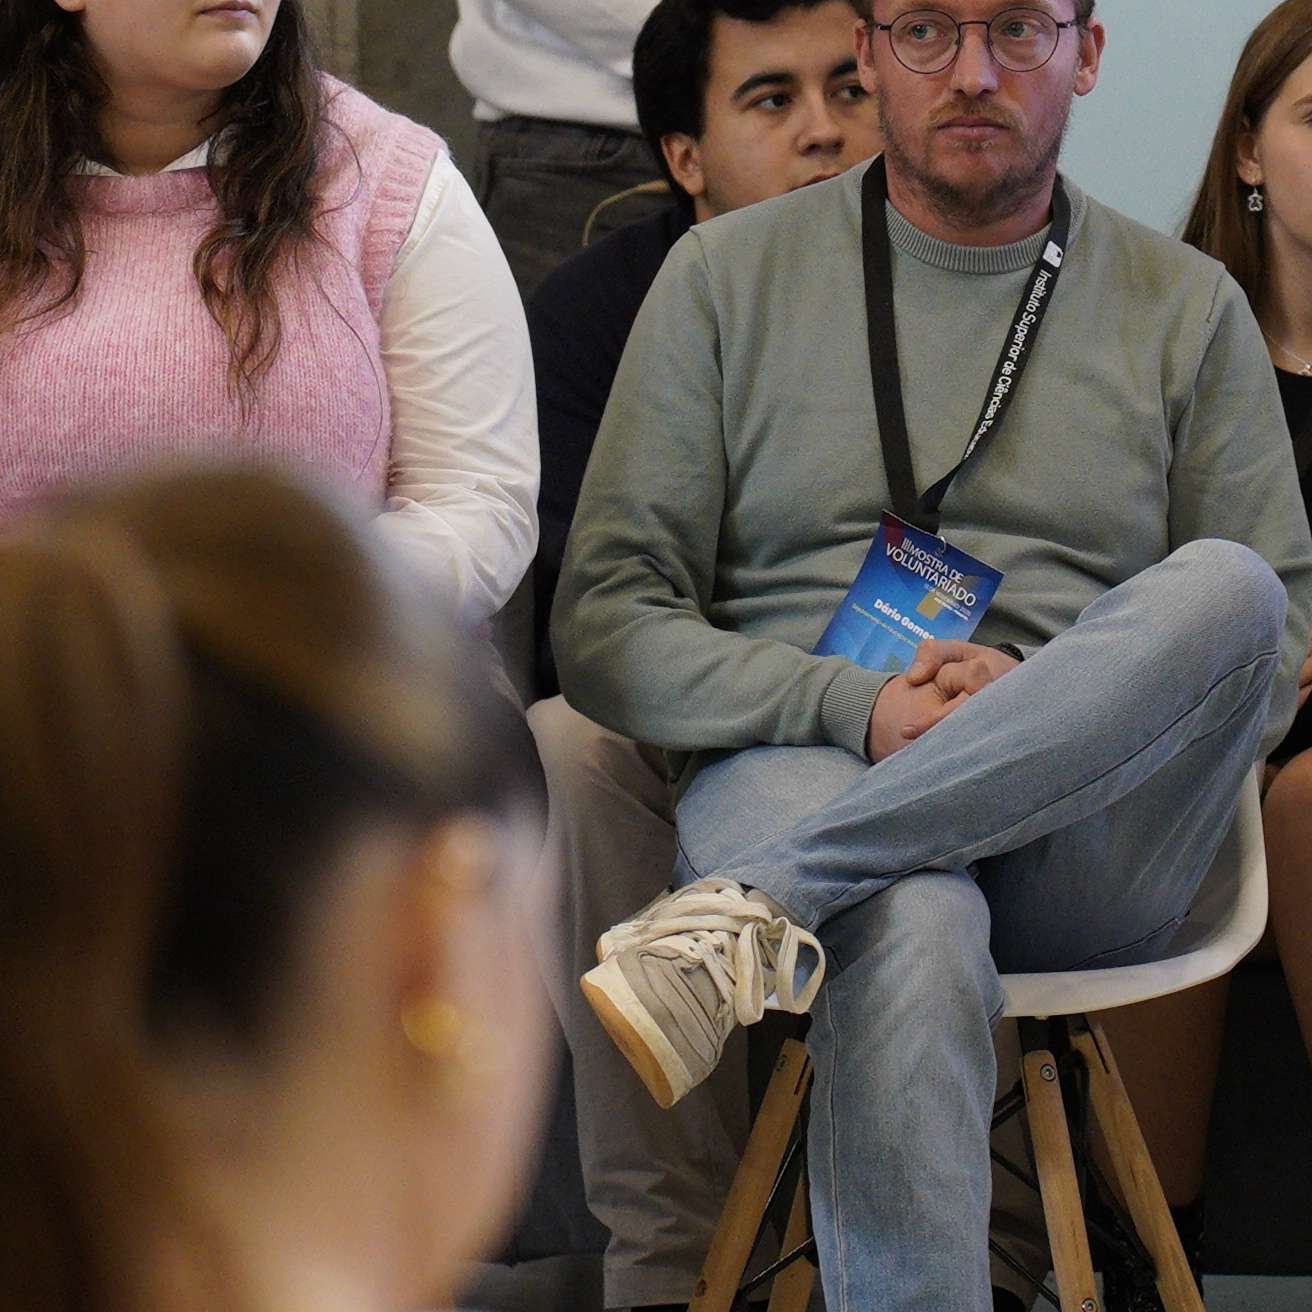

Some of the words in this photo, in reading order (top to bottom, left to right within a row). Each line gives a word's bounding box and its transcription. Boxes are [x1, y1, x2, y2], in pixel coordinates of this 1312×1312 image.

[1026, 269, 1053, 313] Instituto
[1008, 312, 1037, 367] Superior
[1001, 360, 1018, 377] de
[885, 543, 977, 607] VOLUNTARIADO
[908, 544, 953, 577] MOSTRA
[950, 567, 964, 584] DE
[874, 598, 902, 621] Dário
